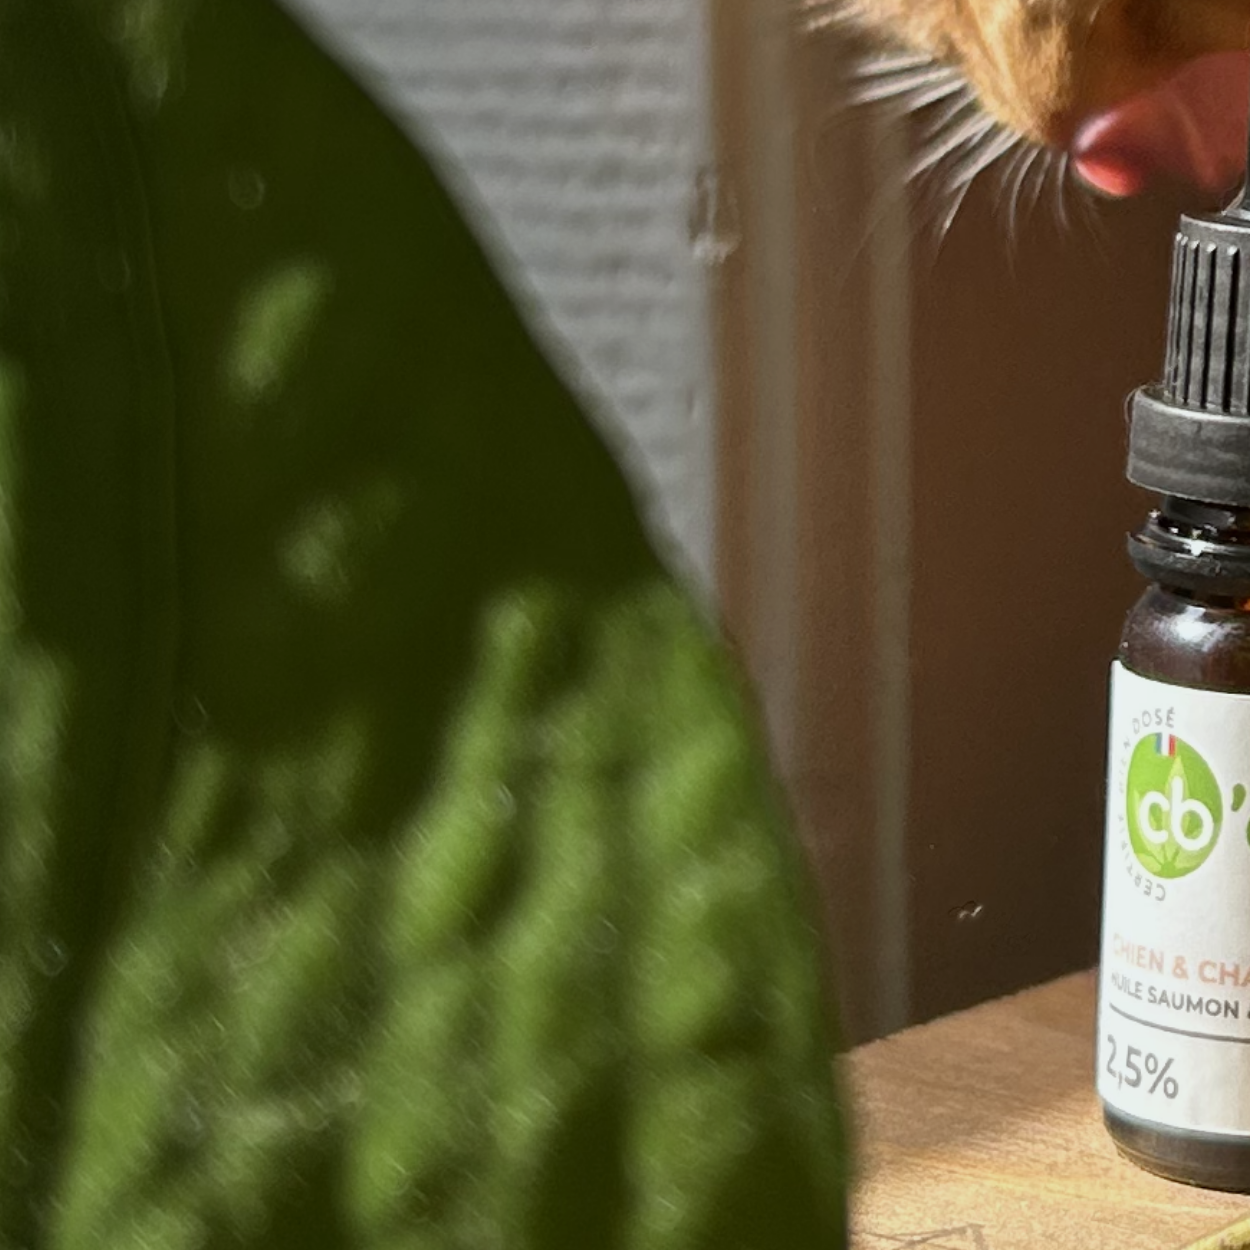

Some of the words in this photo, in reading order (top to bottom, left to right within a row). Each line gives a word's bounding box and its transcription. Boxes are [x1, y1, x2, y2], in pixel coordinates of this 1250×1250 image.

[1132, 706, 1175, 734] DOSÉ
[1113, 932, 1164, 974] CHIEN
[1172, 955, 1189, 980] &
[1147, 985, 1239, 1019] SAUMON
[1107, 1034, 1179, 1099] 2,5%
